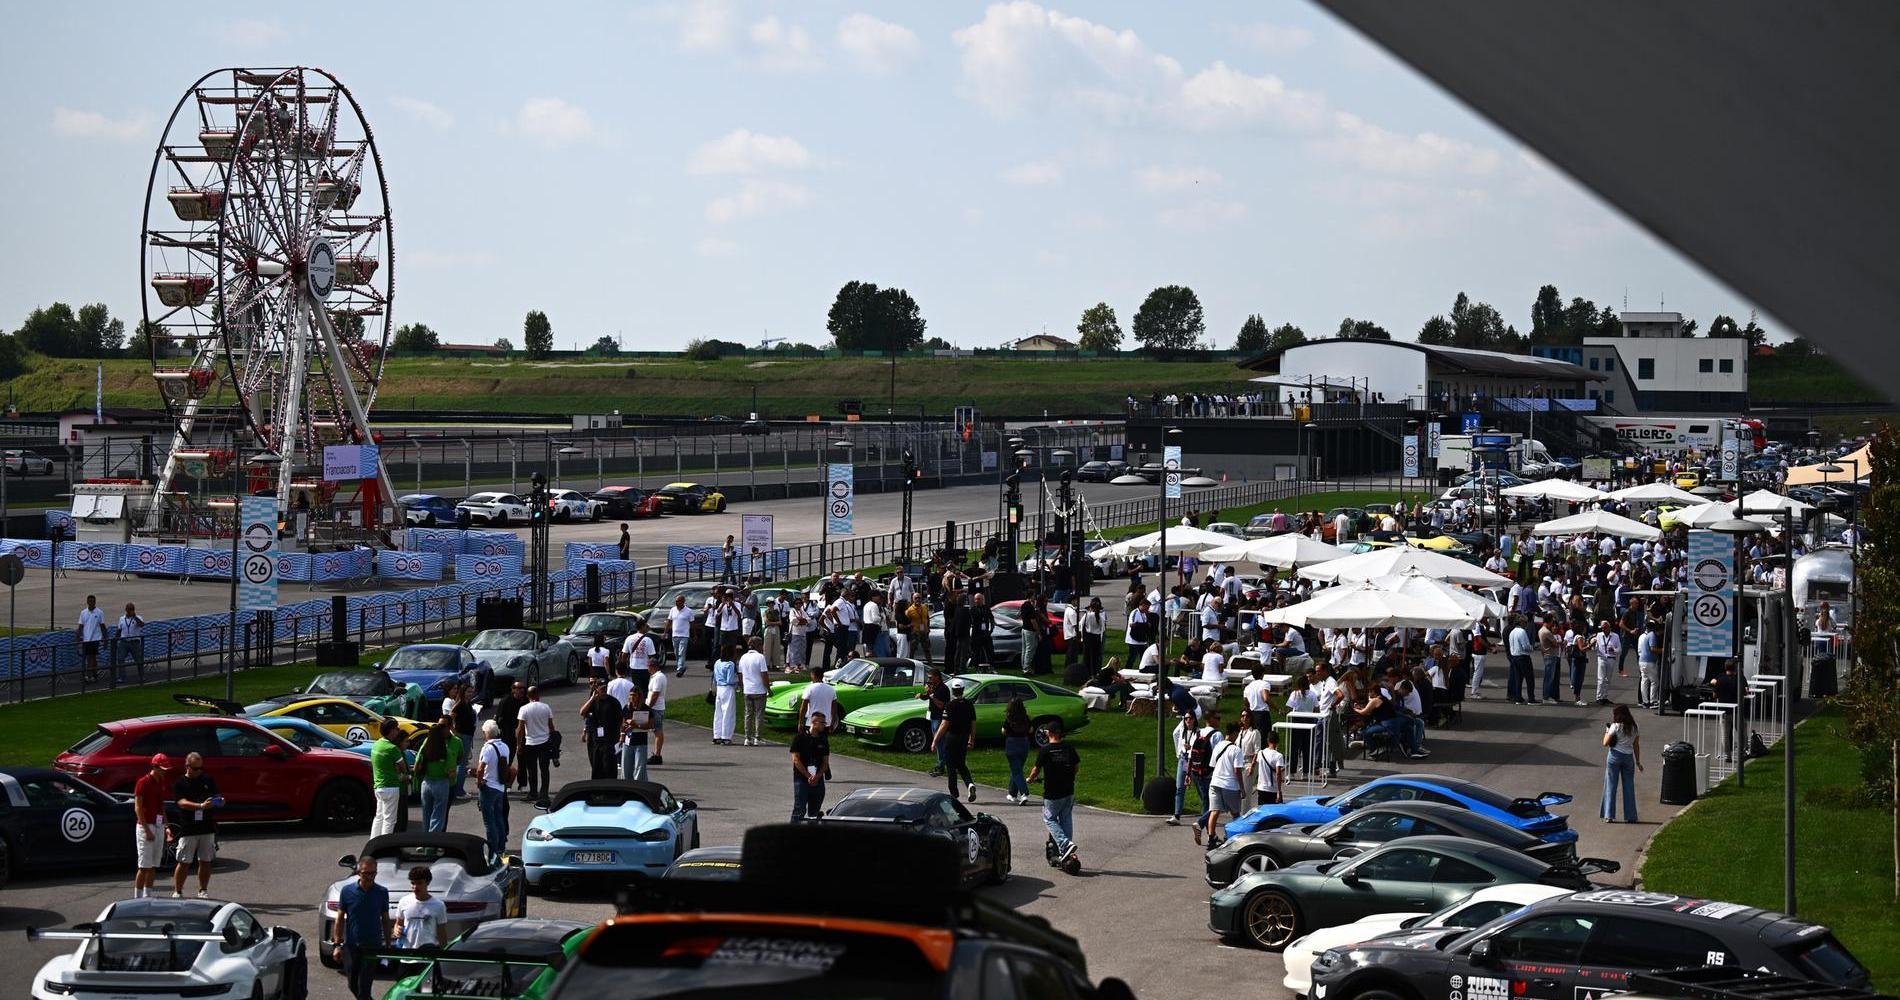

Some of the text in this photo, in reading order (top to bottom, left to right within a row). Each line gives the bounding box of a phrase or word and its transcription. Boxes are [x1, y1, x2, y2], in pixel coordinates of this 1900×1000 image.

[834, 504, 846, 513] 26
[30, 549, 39, 557] 26
[93, 550, 102, 559] 26
[249, 562, 267, 575] 26
[280, 562, 289, 570] 26
[1700, 602, 1720, 617] 26
[69, 817, 87, 831] 26
[1706, 952, 1725, 965] RS
